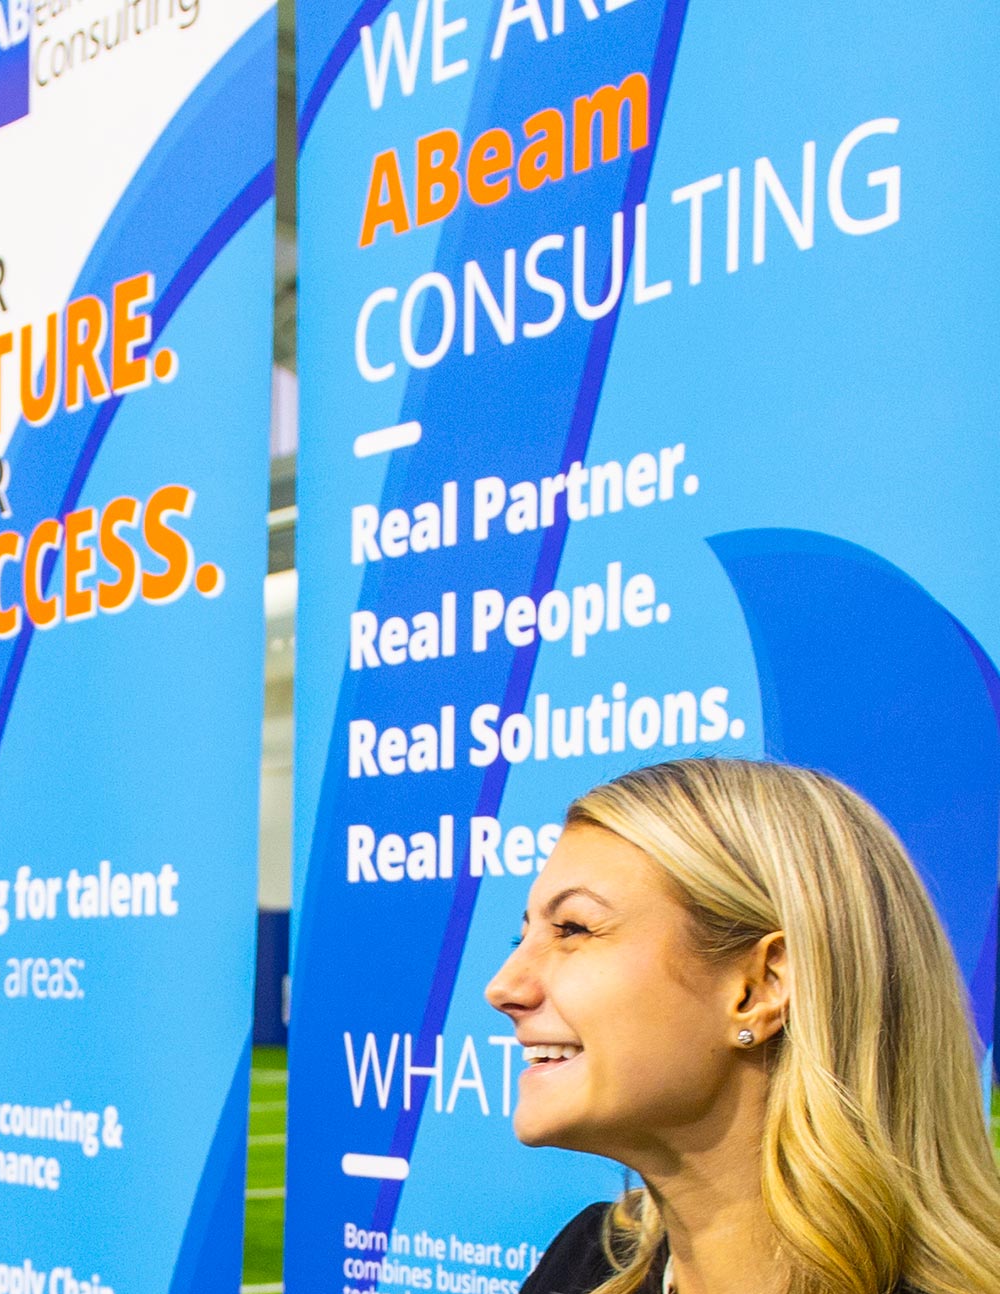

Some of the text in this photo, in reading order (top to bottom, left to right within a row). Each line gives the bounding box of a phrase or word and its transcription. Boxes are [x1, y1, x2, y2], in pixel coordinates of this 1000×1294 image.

[360, 0, 470, 110] WE
[358, 72, 650, 248] ABeam
[355, 117, 901, 383] CONSULTING
[351, 443, 699, 565] Real Partner.
[350, 561, 672, 671] Real People.
[348, 682, 746, 779] Real Solutions.
[14, 865, 62, 920] for
[67, 860, 179, 920] talent
[347, 814, 454, 884] Real
[4, 957, 85, 1000] areas:
[344, 1031, 520, 1117] WHAT
[102, 1105, 124, 1149] &
[343, 1222, 388, 1252] Born
[391, 1228, 410, 1255] in
[413, 1230, 446, 1261] the
[451, 1233, 502, 1268] heart
[505, 1241, 528, 1271] of
[343, 1257, 432, 1290] combines
